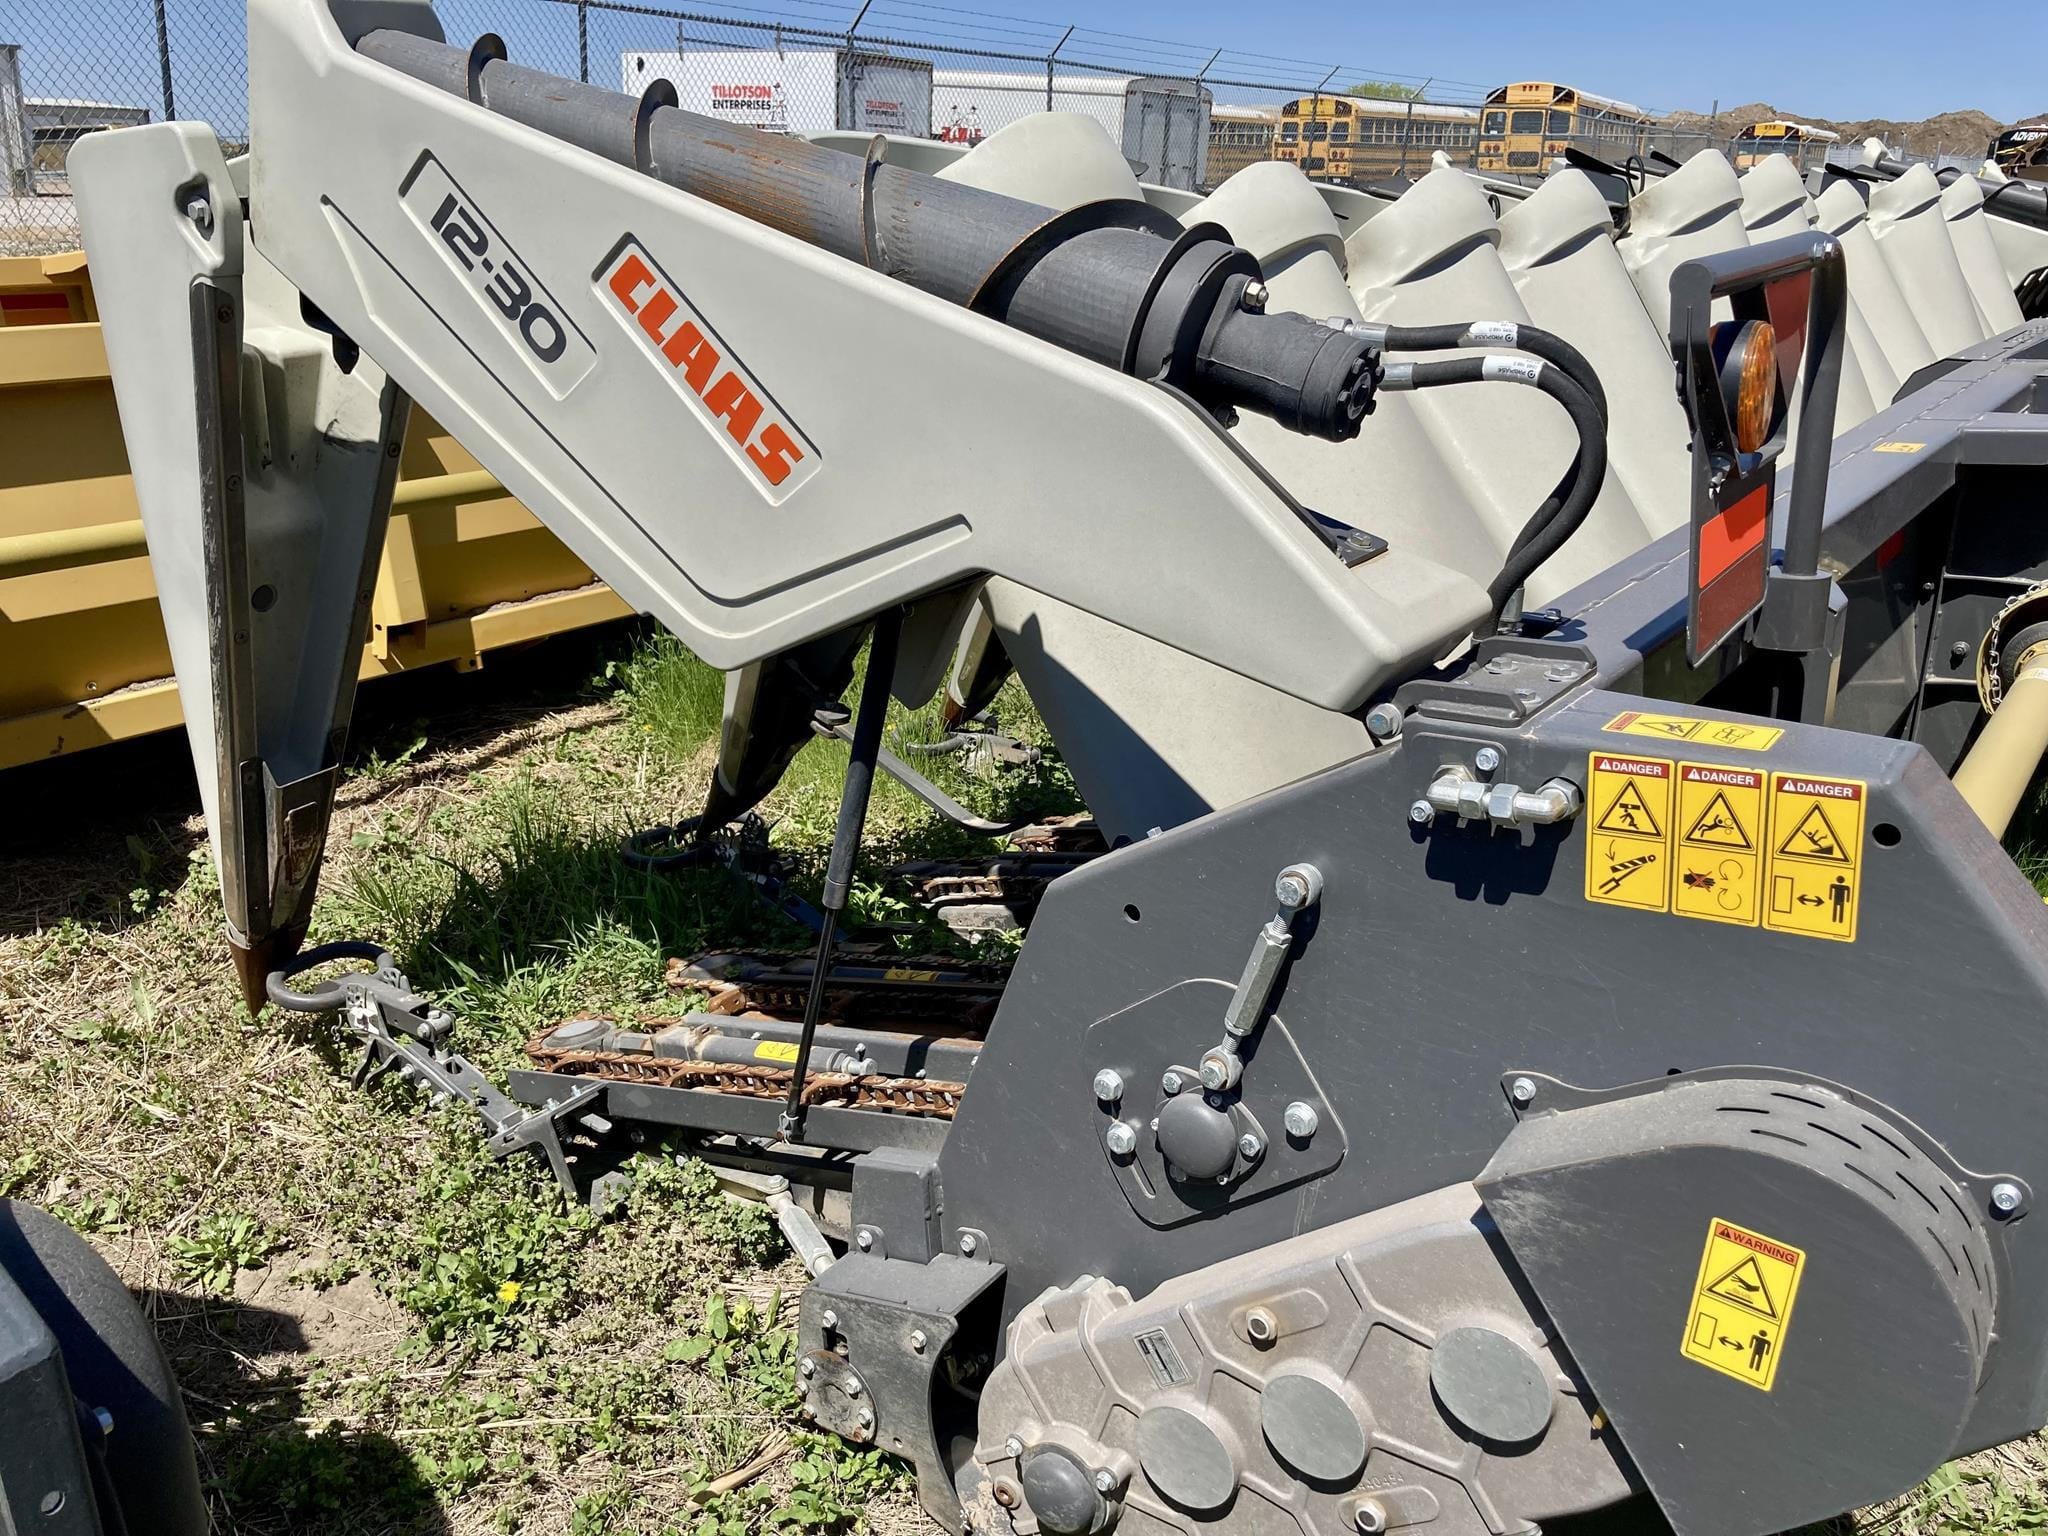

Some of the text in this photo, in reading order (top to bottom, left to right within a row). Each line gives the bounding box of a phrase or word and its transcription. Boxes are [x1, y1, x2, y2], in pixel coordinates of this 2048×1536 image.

[711, 85, 771, 99] TILLOTSON
[712, 99, 771, 110] ENTERPRISES
[430, 192, 567, 363] 12-30
[609, 254, 805, 486] CLAAS
[1612, 761, 1662, 776] DANGER
[1700, 771, 1755, 787] DANGER
[1796, 782, 1853, 798] DANGER
[1733, 1232, 1795, 1263] WARNING
